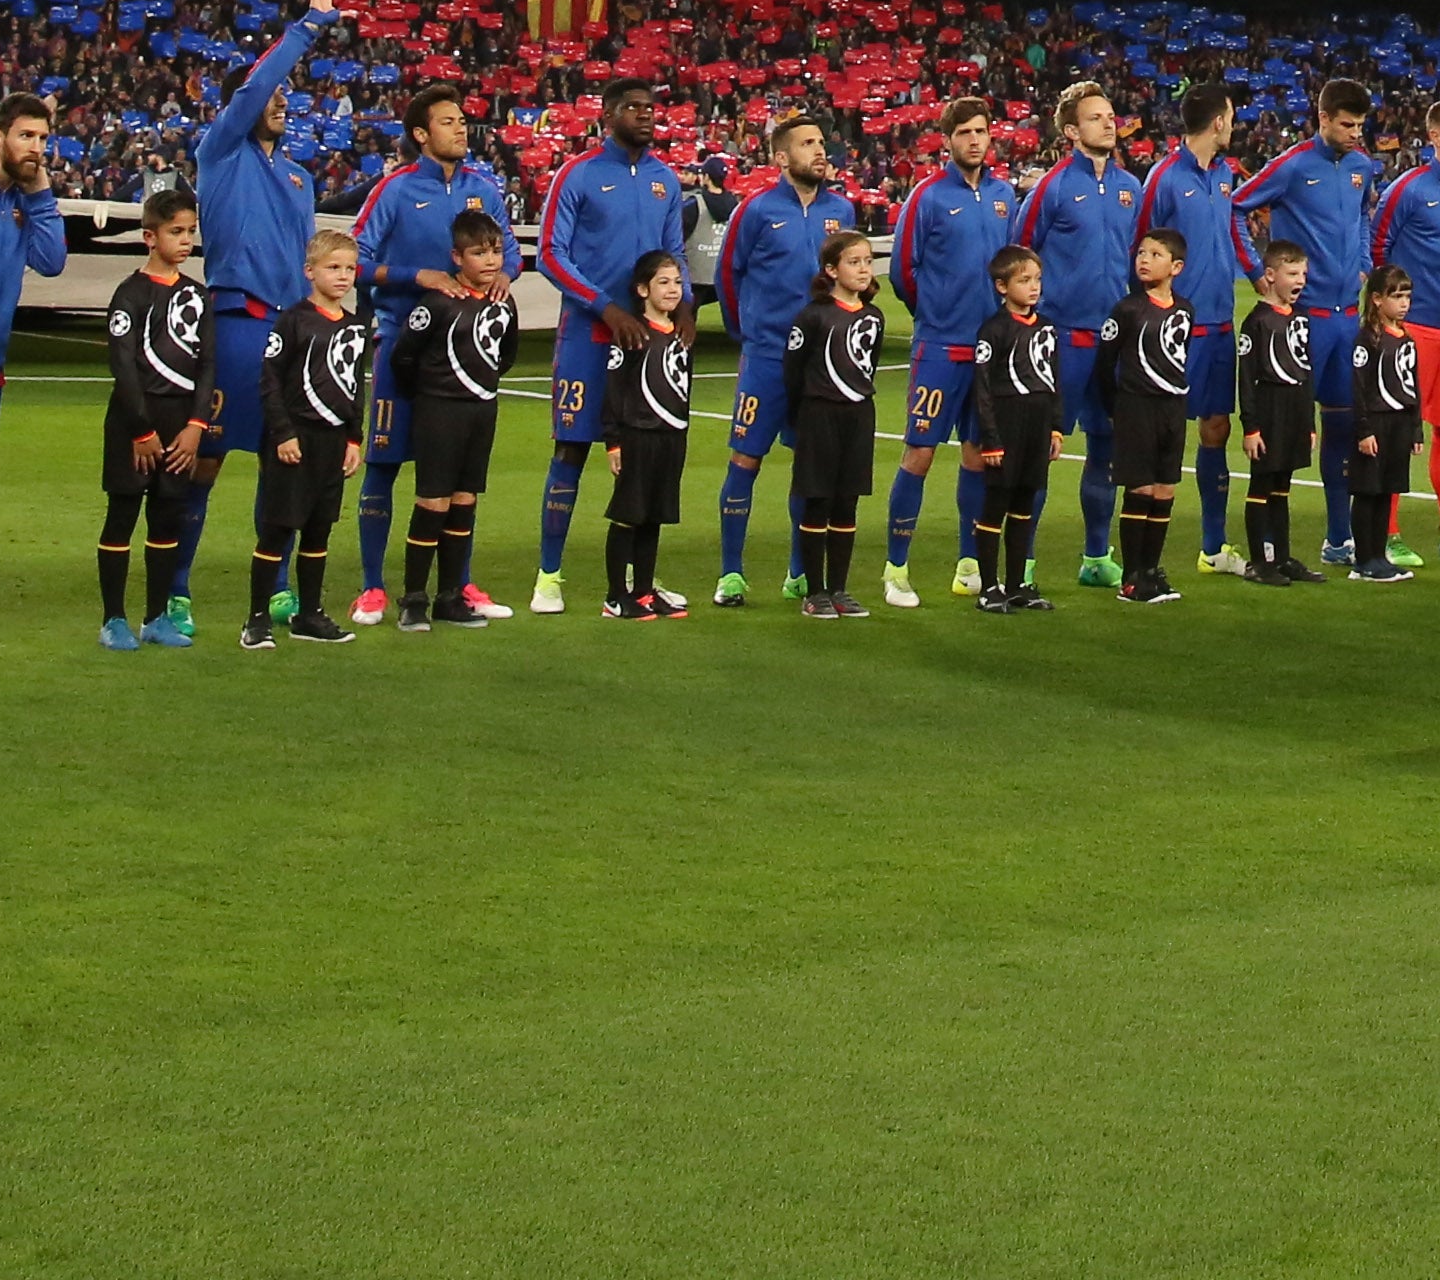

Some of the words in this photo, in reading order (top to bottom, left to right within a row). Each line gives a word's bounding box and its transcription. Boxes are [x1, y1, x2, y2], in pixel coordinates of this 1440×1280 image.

[210, 389, 224, 421] 9
[557, 379, 585, 411] 23
[736, 391, 759, 426] 18
[912, 386, 943, 418] 20
[376, 398, 394, 432] 11
